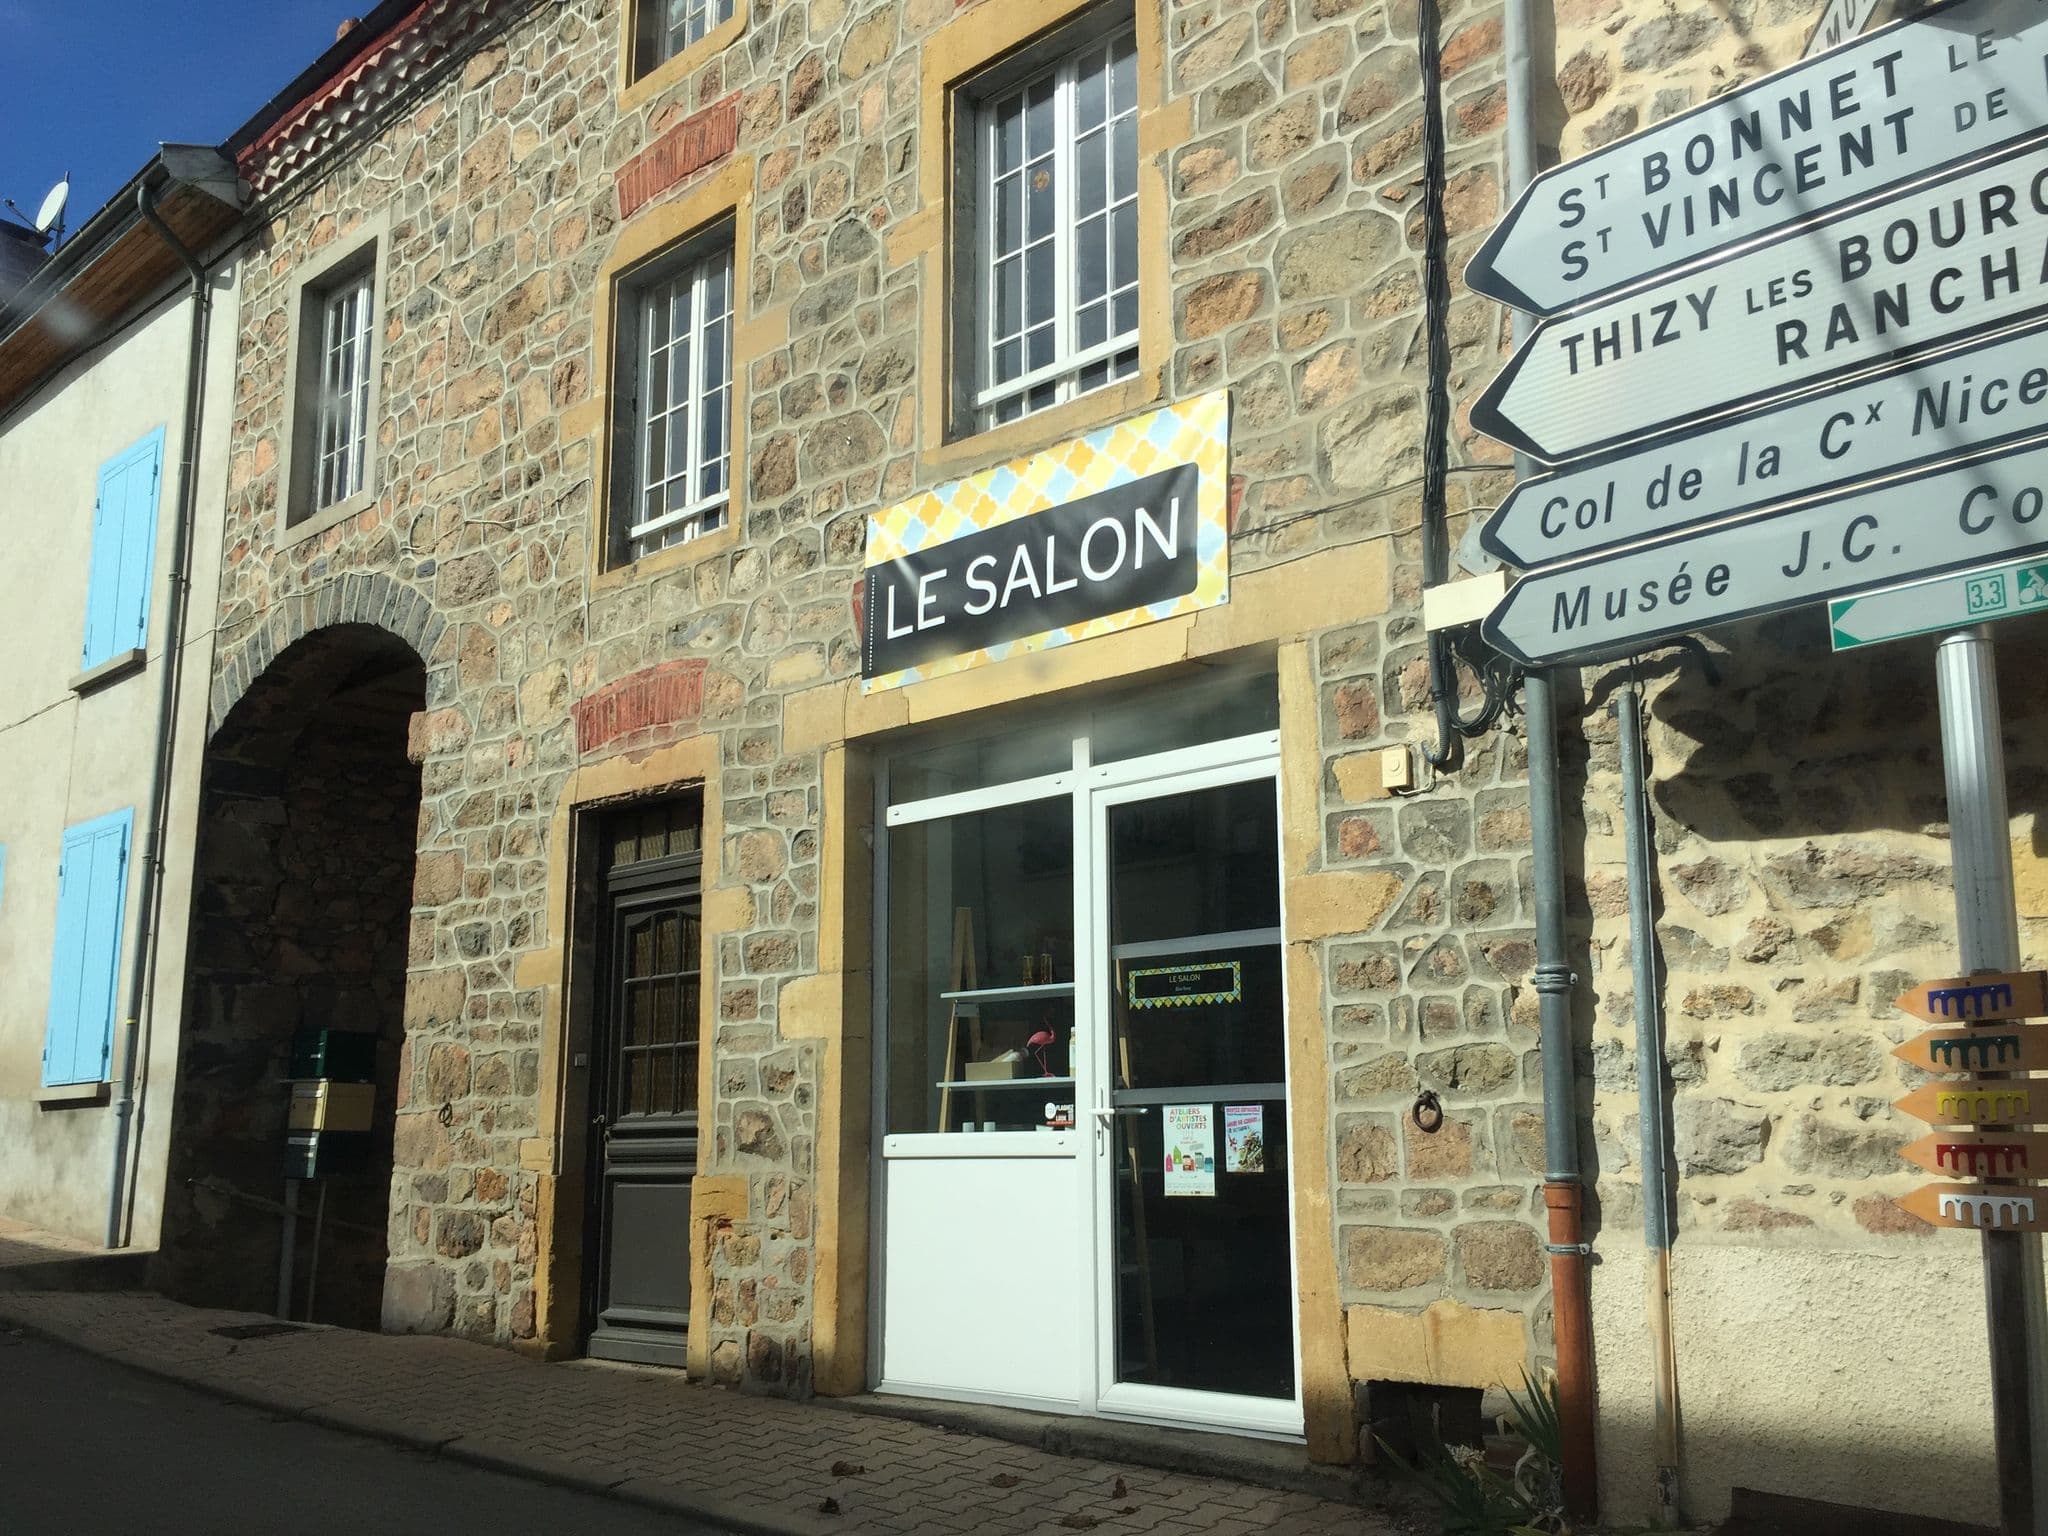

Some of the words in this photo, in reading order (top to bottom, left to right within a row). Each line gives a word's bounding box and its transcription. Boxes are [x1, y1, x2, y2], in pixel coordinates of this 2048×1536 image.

[1641, 106, 1914, 250] VINCENT
[1953, 87, 2008, 133] DE
[1642, 50, 1903, 196] BONNET
[1948, 28, 1998, 73] LE
[1560, 285, 1718, 375] THIZY
[1746, 269, 1813, 315] LES
[1775, 235, 2048, 367] RANCH
[1540, 481, 1616, 540] Col
[1646, 463, 1703, 510] de
[1737, 441, 1781, 486] la
[1911, 366, 2048, 437] Nice
[886, 568, 948, 640] LE
[963, 497, 1179, 616] SALON
[1551, 561, 1731, 634] Musée
[1781, 514, 1903, 578] J.C.
[1958, 484, 2044, 536] Co
[1970, 580, 2002, 609] 3.3
[1168, 975, 1177, 984] LE
[1178, 972, 1201, 983] SALON
[1169, 1107, 1201, 1115] ATELIERS
[1176, 1122, 1207, 1130] OUVERTS
